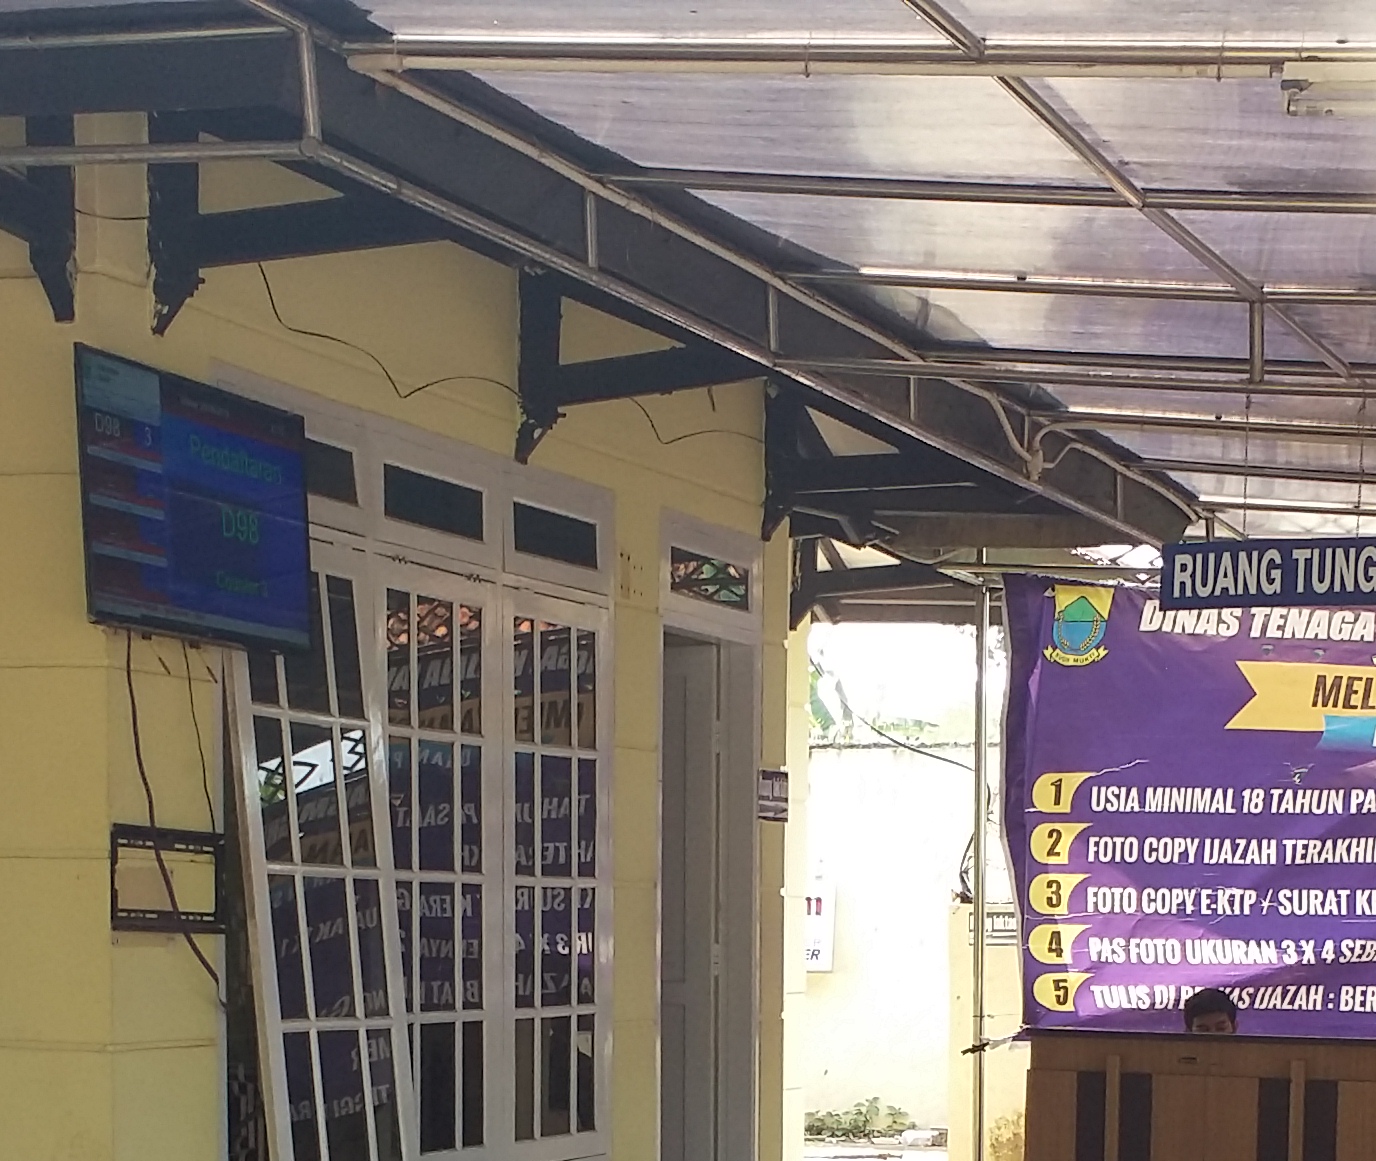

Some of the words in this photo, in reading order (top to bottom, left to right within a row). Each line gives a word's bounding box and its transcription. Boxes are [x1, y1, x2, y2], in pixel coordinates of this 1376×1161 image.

[1173, 549, 1282, 598] RUANG
[1139, 599, 1242, 637] DINAS
[1249, 607, 1376, 639] TENAGA
[1049, 778, 1062, 806] 1
[1091, 786, 1139, 813] USIA
[1145, 787, 1236, 814] MINIMAL
[1241, 787, 1264, 814] 18
[1270, 788, 1344, 815] TAHUN
[1047, 828, 1062, 857] 2
[1087, 836, 1138, 864] FOTO
[1143, 836, 1201, 864] COPY
[1204, 837, 1277, 865] IJAZAH
[1046, 880, 1062, 908] 3
[1086, 887, 1137, 914] FOTO
[1142, 887, 1196, 916] COPY
[1200, 888, 1257, 917] E-KTP
[1278, 888, 1351, 916] SURAT
[1047, 931, 1063, 959] 4
[1089, 937, 1127, 963] PAS
[1129, 938, 1181, 964] FOTO
[1186, 939, 1278, 965] UKURAN
[1281, 939, 1297, 963] 3
[1300, 940, 1316, 964] X
[1320, 939, 1335, 963] 4
[1052, 978, 1069, 1005] 5
[1089, 985, 1152, 1010] TULIS
[1154, 985, 1176, 1010] DI
[1255, 985, 1325, 1011] IJAZAH
